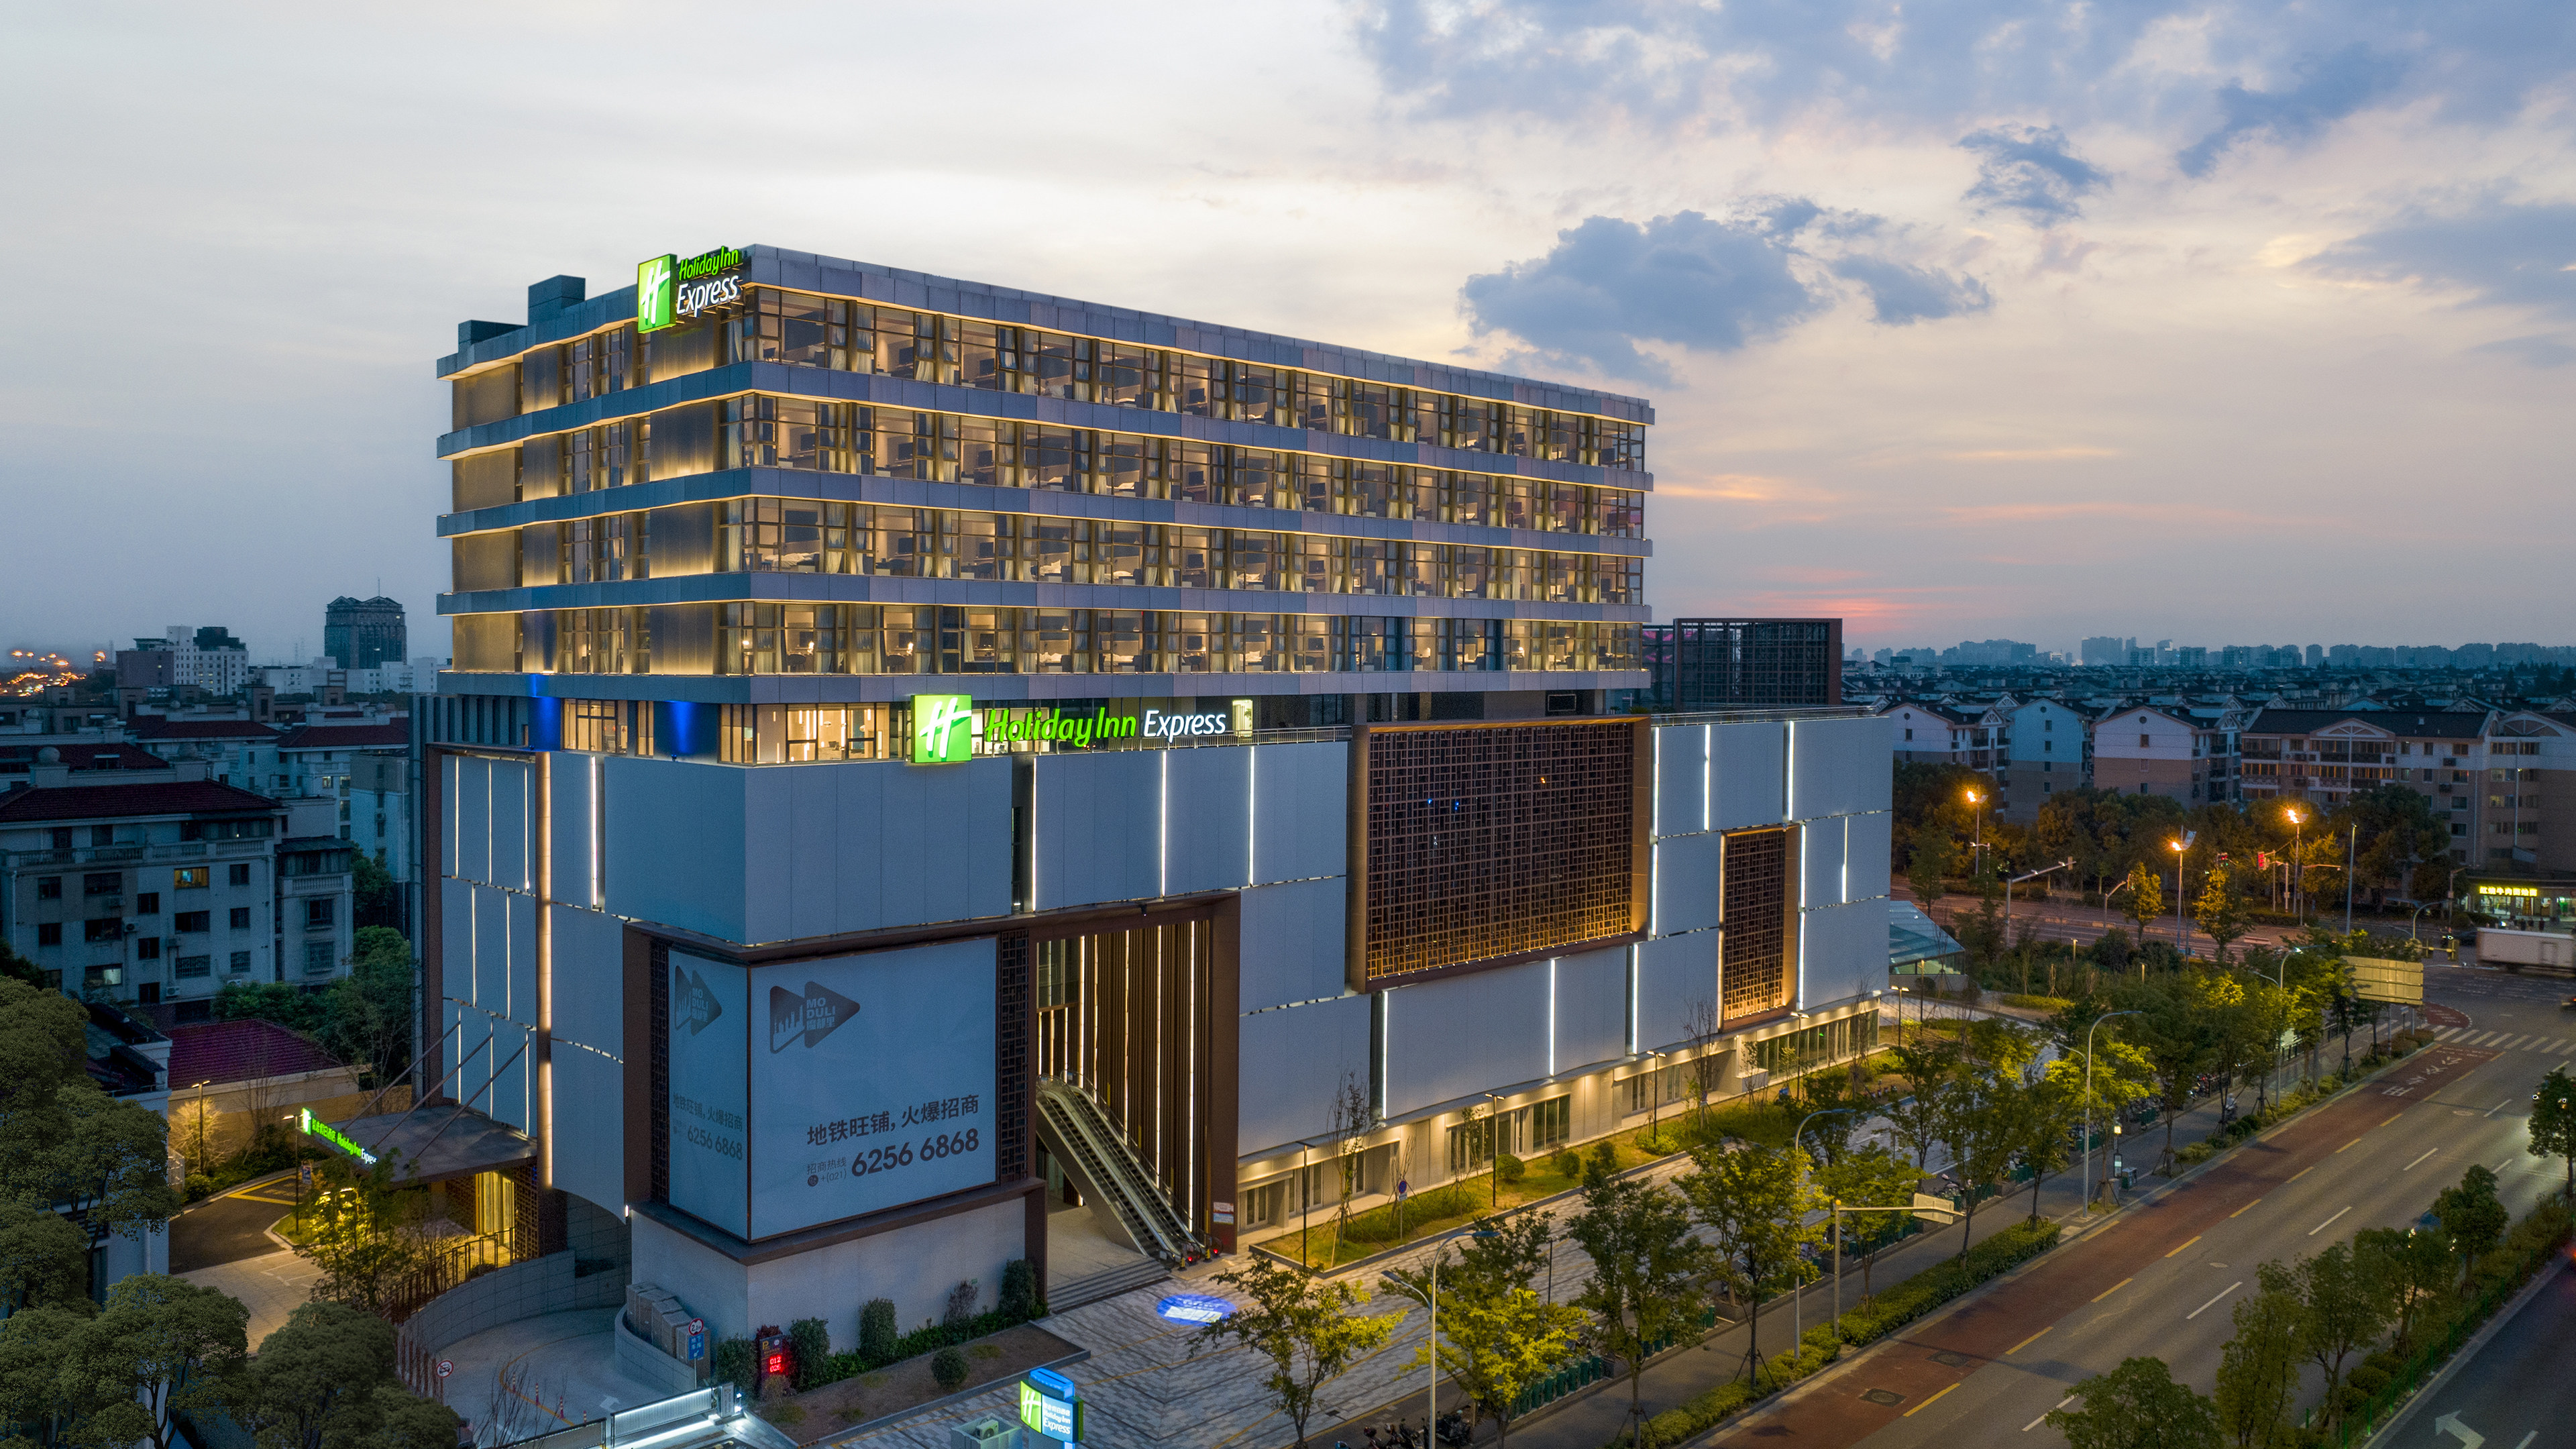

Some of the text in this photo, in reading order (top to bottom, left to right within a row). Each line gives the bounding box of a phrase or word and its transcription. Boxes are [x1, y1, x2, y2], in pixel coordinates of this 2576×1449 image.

[676, 275, 739, 318] Express
[1143, 709, 1227, 743] Express
[806, 997, 826, 1009] MO
[806, 1006, 836, 1019] DULI
[688, 1124, 712, 1150] 6256
[715, 1135, 743, 1161] 6868
[851, 1127, 979, 1177] 6256 6868
[807, 1156, 847, 1175] 招商热线
[769, 1356, 782, 1364] 012
[1043, 1410, 1062, 1423] Holiday
[1043, 1417, 1071, 1434] Express
